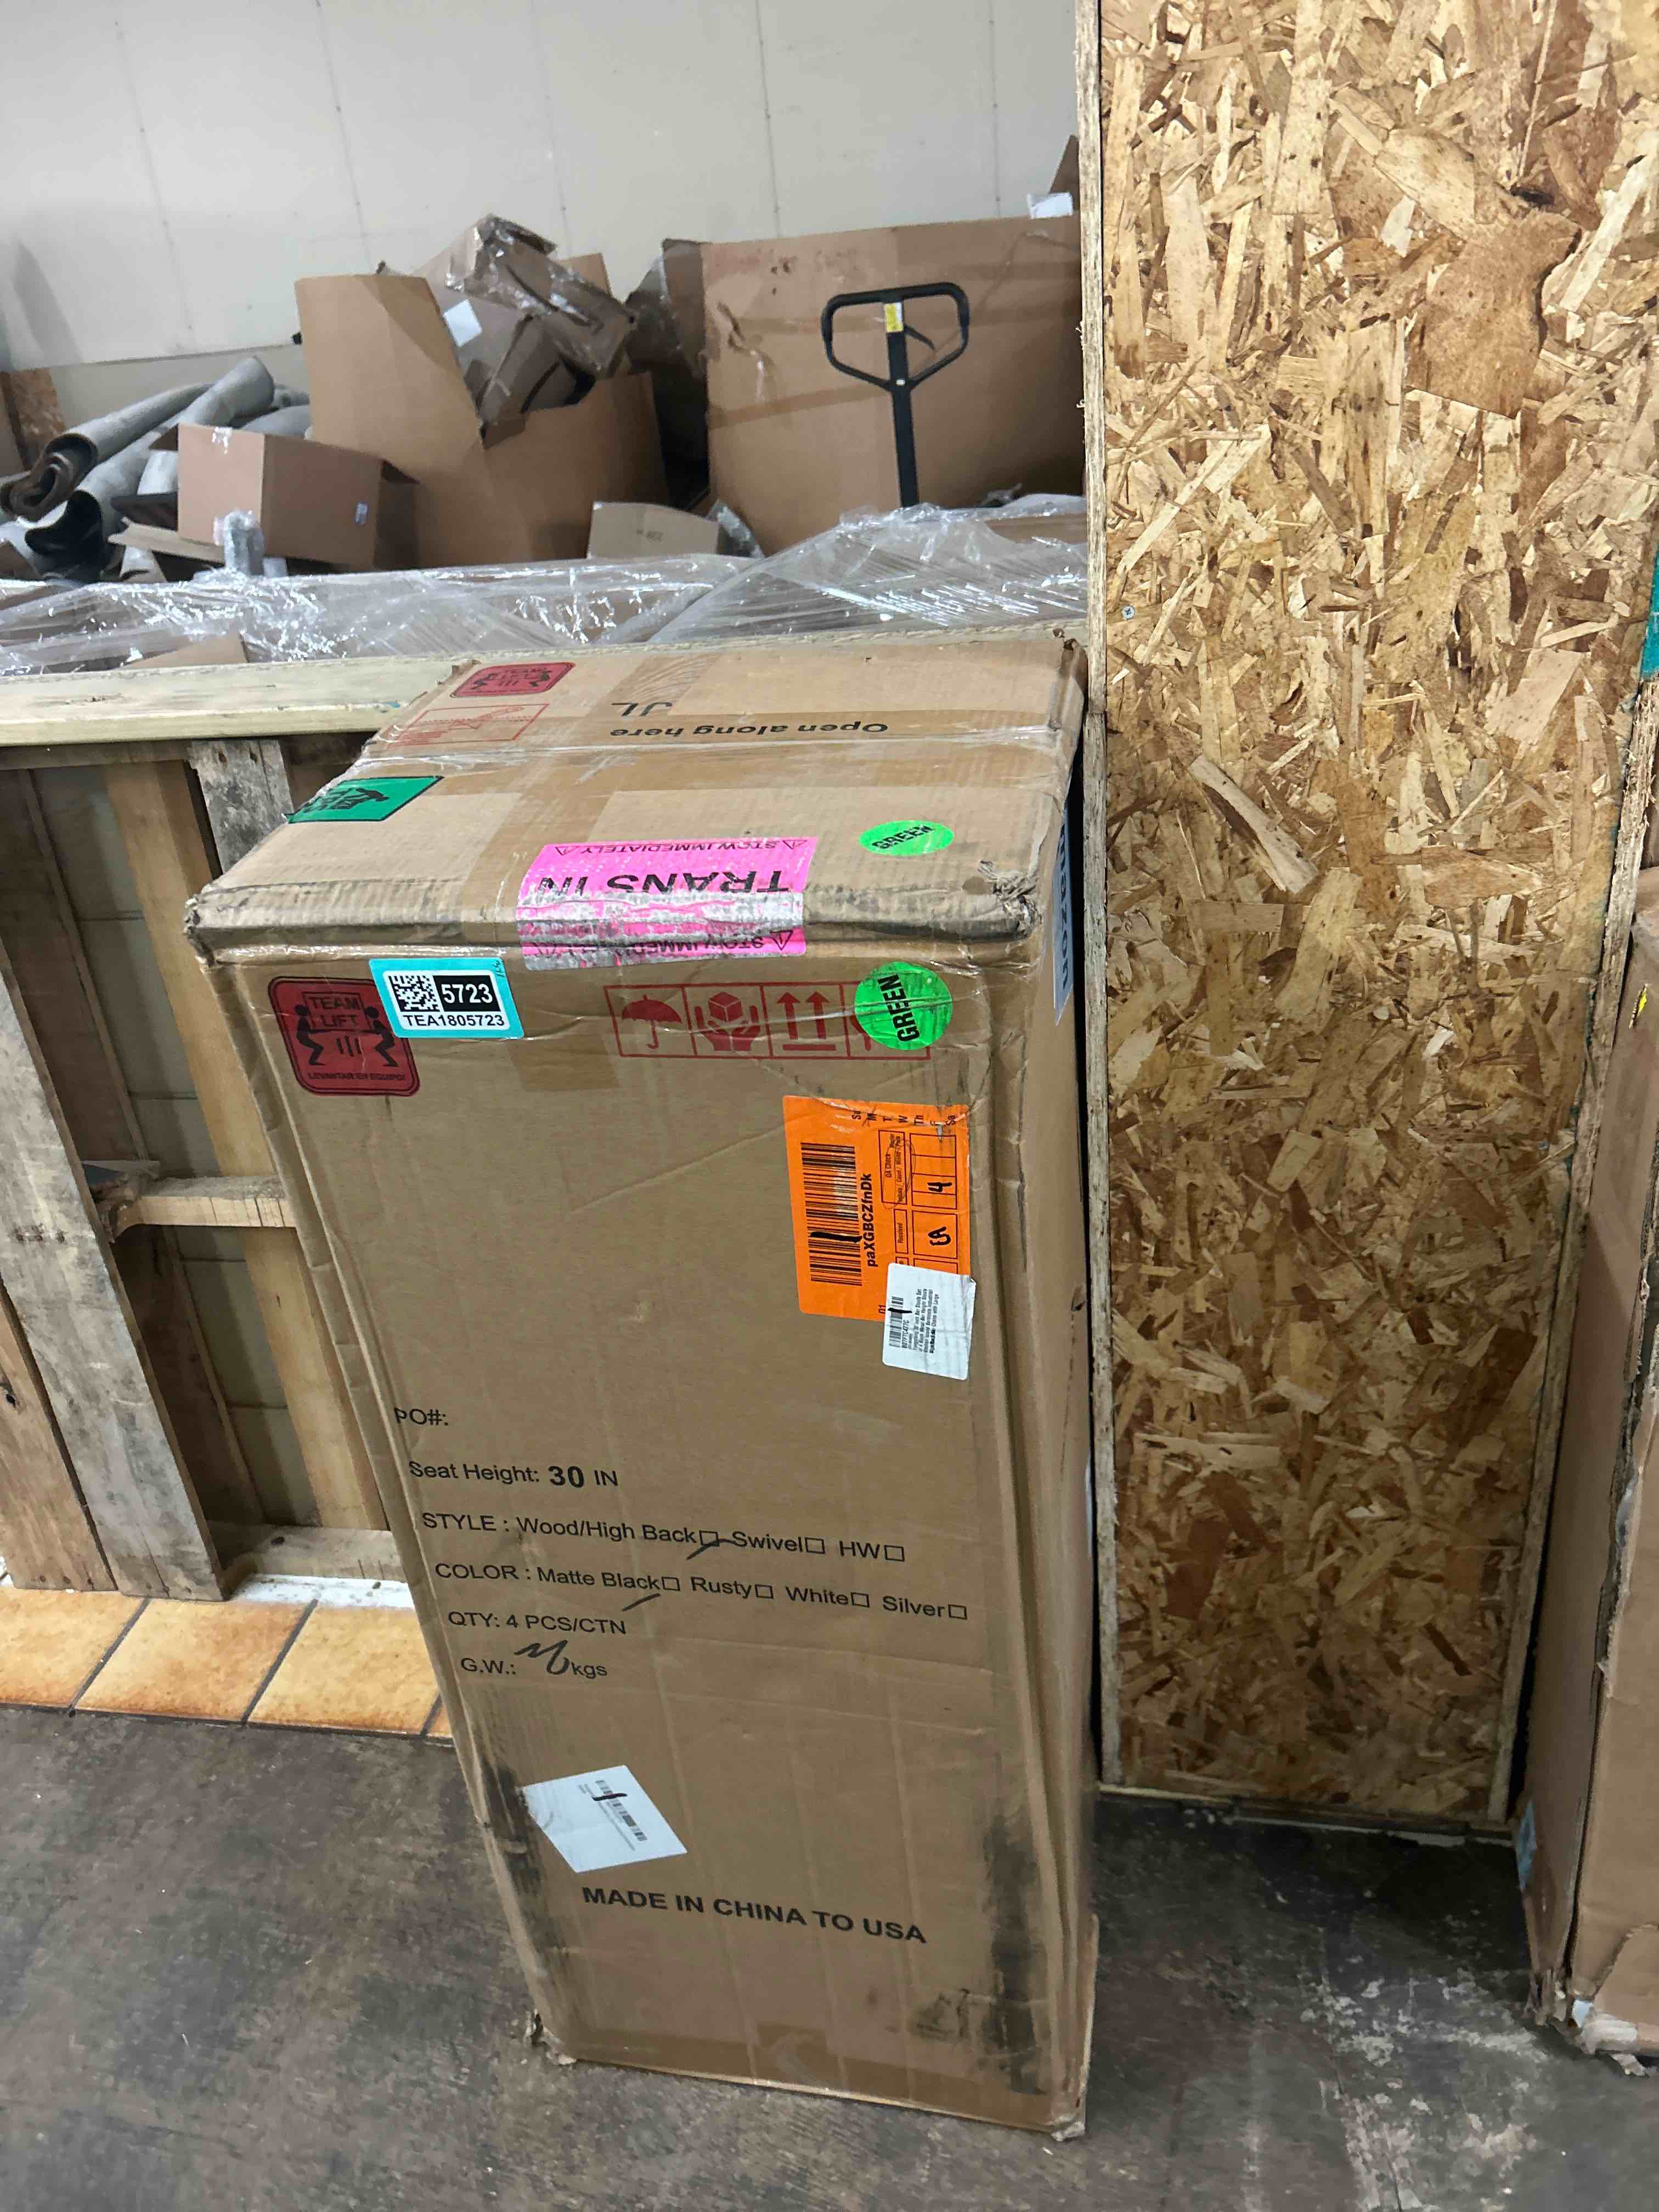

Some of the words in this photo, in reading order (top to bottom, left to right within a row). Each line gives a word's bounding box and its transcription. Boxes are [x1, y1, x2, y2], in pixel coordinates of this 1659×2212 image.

[610, 728, 684, 738] here
[693, 725, 788, 735] along
[797, 721, 889, 733] Open
[871, 825, 935, 849] GREEN
[580, 843, 714, 854] IMMEDIATELY
[539, 876, 589, 896] IN
[606, 871, 789, 894] TRANS
[442, 983, 493, 1005] 5723
[308, 995, 361, 1010] TEAM
[879, 974, 920, 1042] GREEN
[319, 1014, 357, 1028] LIFT
[402, 1013, 505, 1028] TEA1805723
[867, 1113, 877, 1121] M
[898, 1114, 909, 1123] W
[913, 1114, 924, 1126] Th
[946, 1115, 956, 1126] Sa
[927, 1182, 952, 1193] 4
[394, 1408, 449, 1426] PO#:
[409, 1461, 459, 1480] Seat
[465, 1464, 540, 1485] Height:
[548, 1465, 585, 1489] 30
[594, 1469, 619, 1487] IN
[516, 1516, 635, 1543] Wood/High
[641, 1524, 697, 1543] Back
[731, 1531, 803, 1553] Swivel
[839, 1541, 881, 1560] HW
[537, 1566, 595, 1587] Matte
[601, 1572, 661, 1591] Black
[690, 1576, 752, 1600] Rusty
[785, 1586, 849, 1606] White
[882, 1596, 946, 1618] Silver
[448, 1611, 499, 1628] QTY:
[506, 1614, 519, 1628] 4
[526, 1615, 627, 1635] PCS/CTN
[582, 1886, 668, 1911] MADE
[675, 1894, 705, 1914] IN
[713, 1898, 808, 1927] CHINA
[812, 1909, 855, 1933] TO
[863, 1917, 927, 1944] USA
